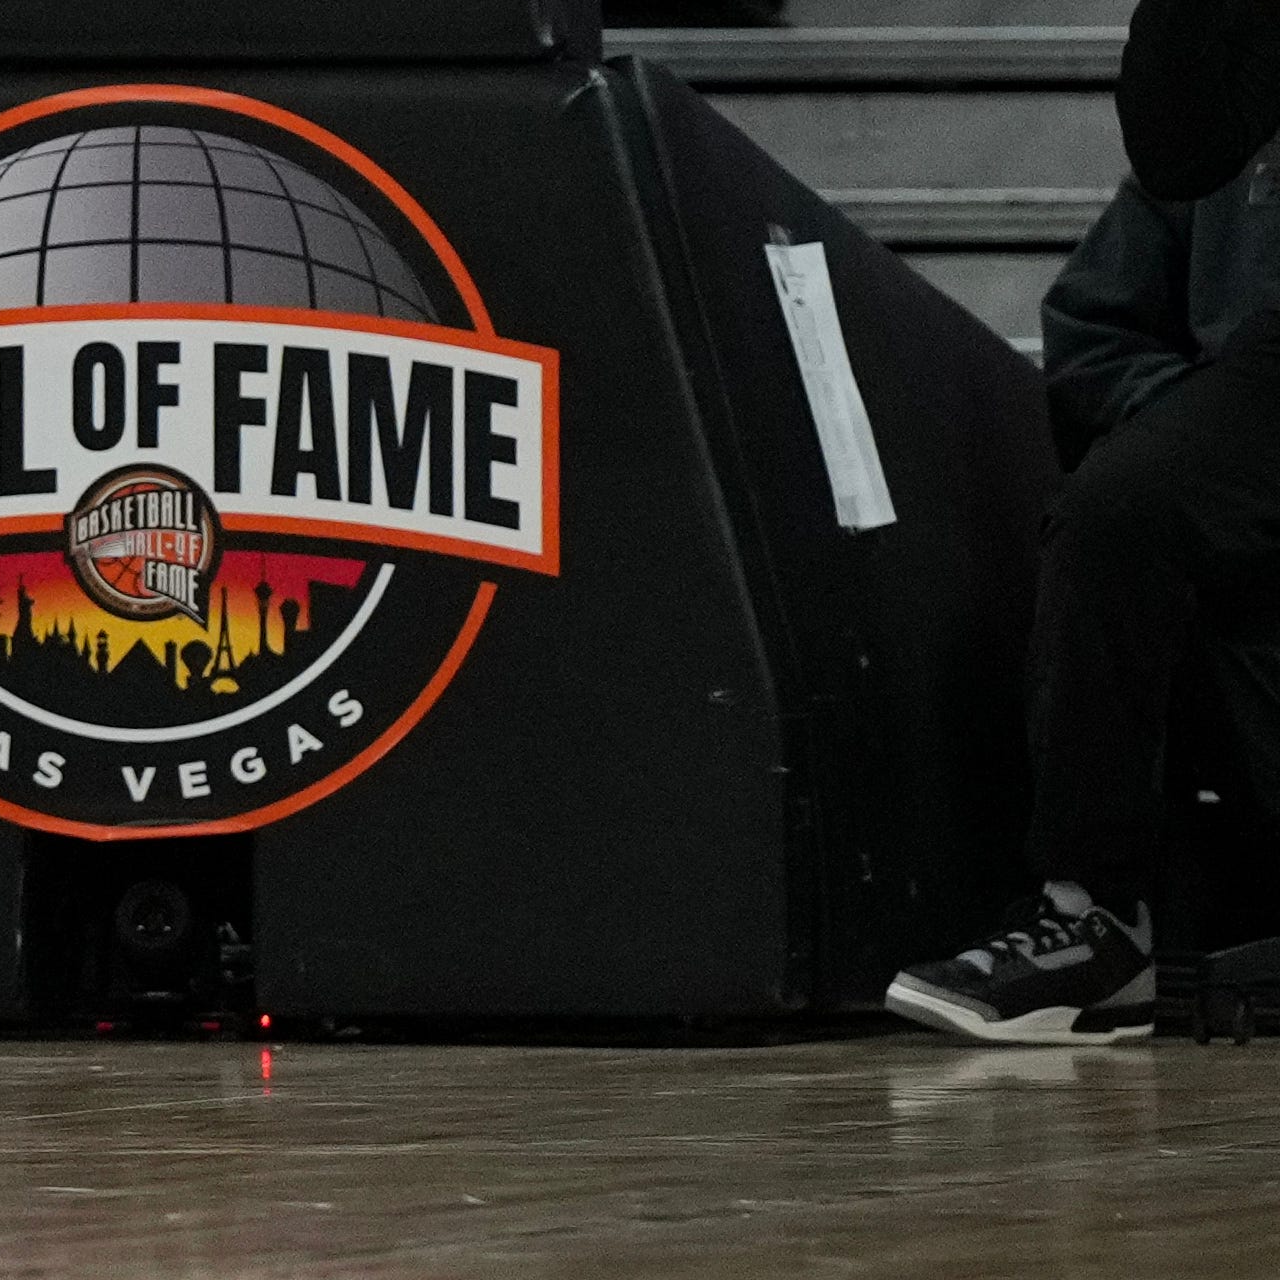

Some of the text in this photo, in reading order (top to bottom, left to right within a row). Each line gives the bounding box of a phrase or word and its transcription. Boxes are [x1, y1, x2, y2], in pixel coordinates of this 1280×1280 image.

[72, 341, 181, 452] OF
[213, 342, 521, 531] FAME
[77, 491, 198, 542] BASKETBALL
[145, 560, 200, 613] FAME
[120, 688, 365, 803] VEGAS
